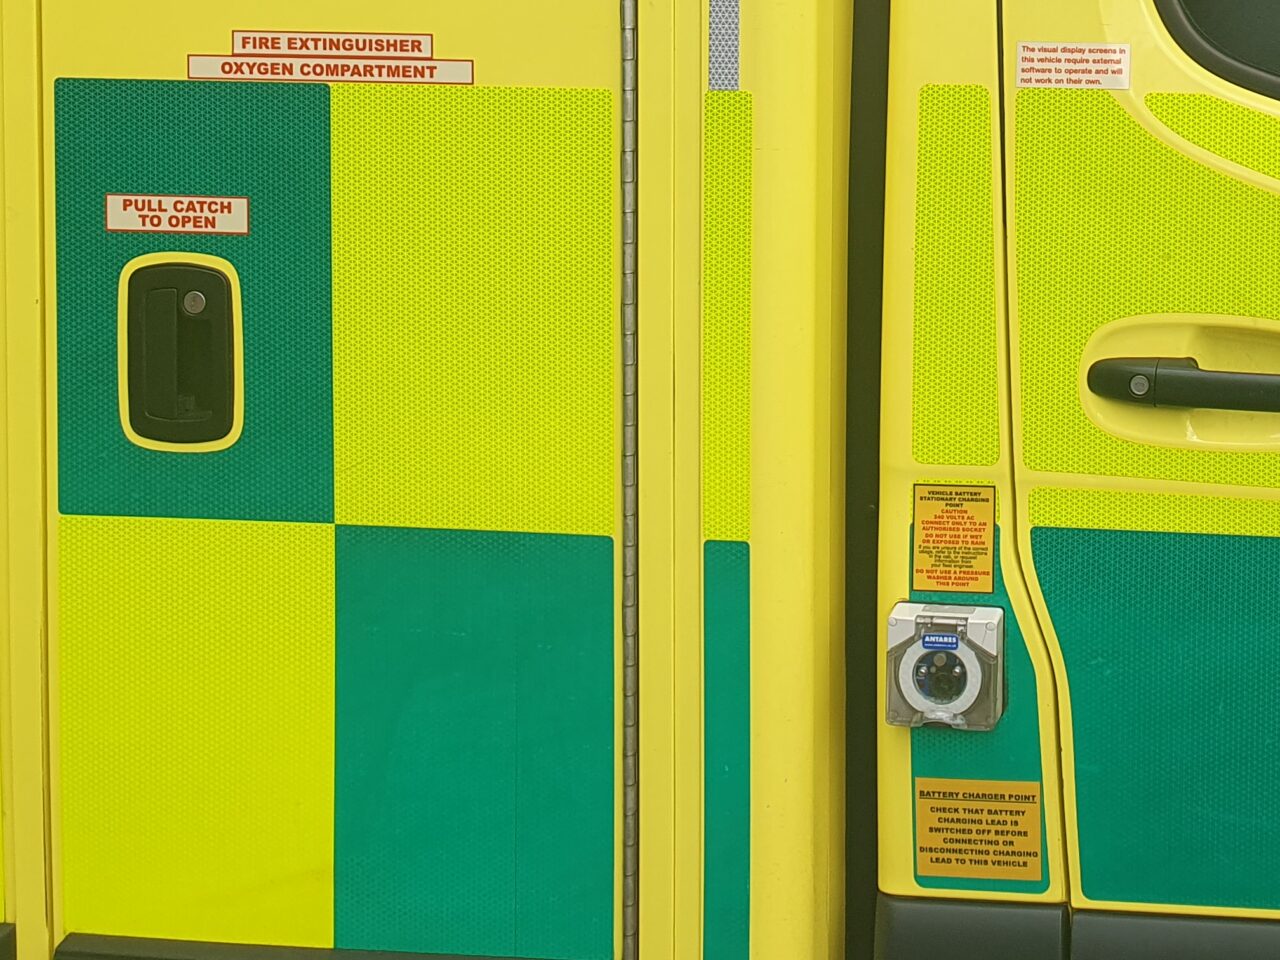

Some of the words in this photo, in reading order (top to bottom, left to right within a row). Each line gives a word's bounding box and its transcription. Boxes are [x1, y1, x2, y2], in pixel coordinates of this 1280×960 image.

[241, 36, 281, 50] FIRE
[287, 38, 422, 53] EXTINGUISHER
[220, 61, 294, 76] OXYGEN
[300, 64, 437, 78] COMPARTMENT
[1064, 68, 1092, 76] operate
[122, 199, 167, 212] PULL
[173, 200, 232, 214] CATCH
[138, 214, 162, 227] TO
[168, 215, 216, 229] OPEN
[919, 790, 960, 798] BATTERY
[962, 792, 1006, 800] CHARGER
[938, 817, 983, 825] CHARGING
[928, 826, 973, 834] SWITCHED
[943, 837, 1000, 846] CONNECTING
[919, 846, 990, 856] DISCONNECTING
[991, 859, 1028, 867] VEHICLE
